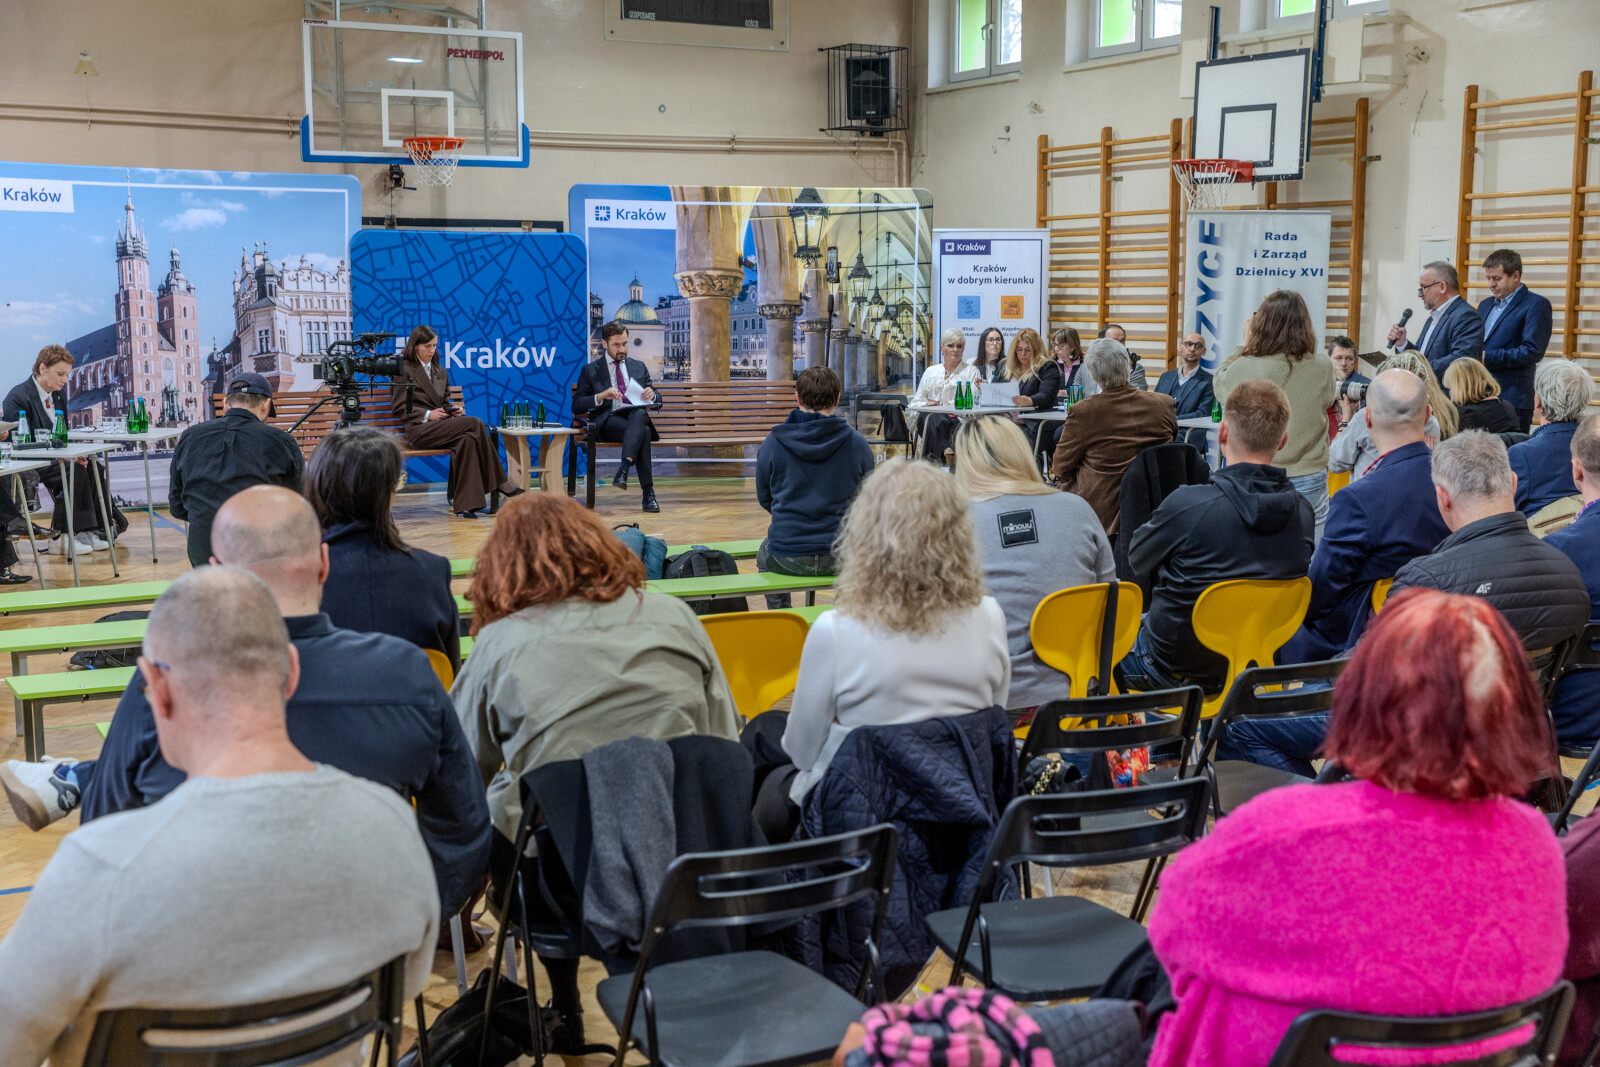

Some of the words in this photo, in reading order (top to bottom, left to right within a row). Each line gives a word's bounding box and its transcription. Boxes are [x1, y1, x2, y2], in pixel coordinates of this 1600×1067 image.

[629, 10, 656, 20] GOSPODARZE
[744, 18, 759, 28] GOŚCIE
[447, 48, 504, 60] PESMENPOL
[3, 187, 61, 202] Kraków
[616, 208, 666, 221] Kraków
[1264, 232, 1298, 241] Rada
[957, 242, 986, 251] Kraków
[1253, 249, 1258, 258] i
[1261, 249, 1307, 261] Zarząd
[973, 264, 1007, 272] Kraków
[1236, 267, 1296, 278] Dzielnicy
[1300, 268, 1324, 276] XVI
[957, 276, 992, 285] dobrym
[994, 276, 1034, 284] kierunku
[444, 336, 557, 369] Kraków
